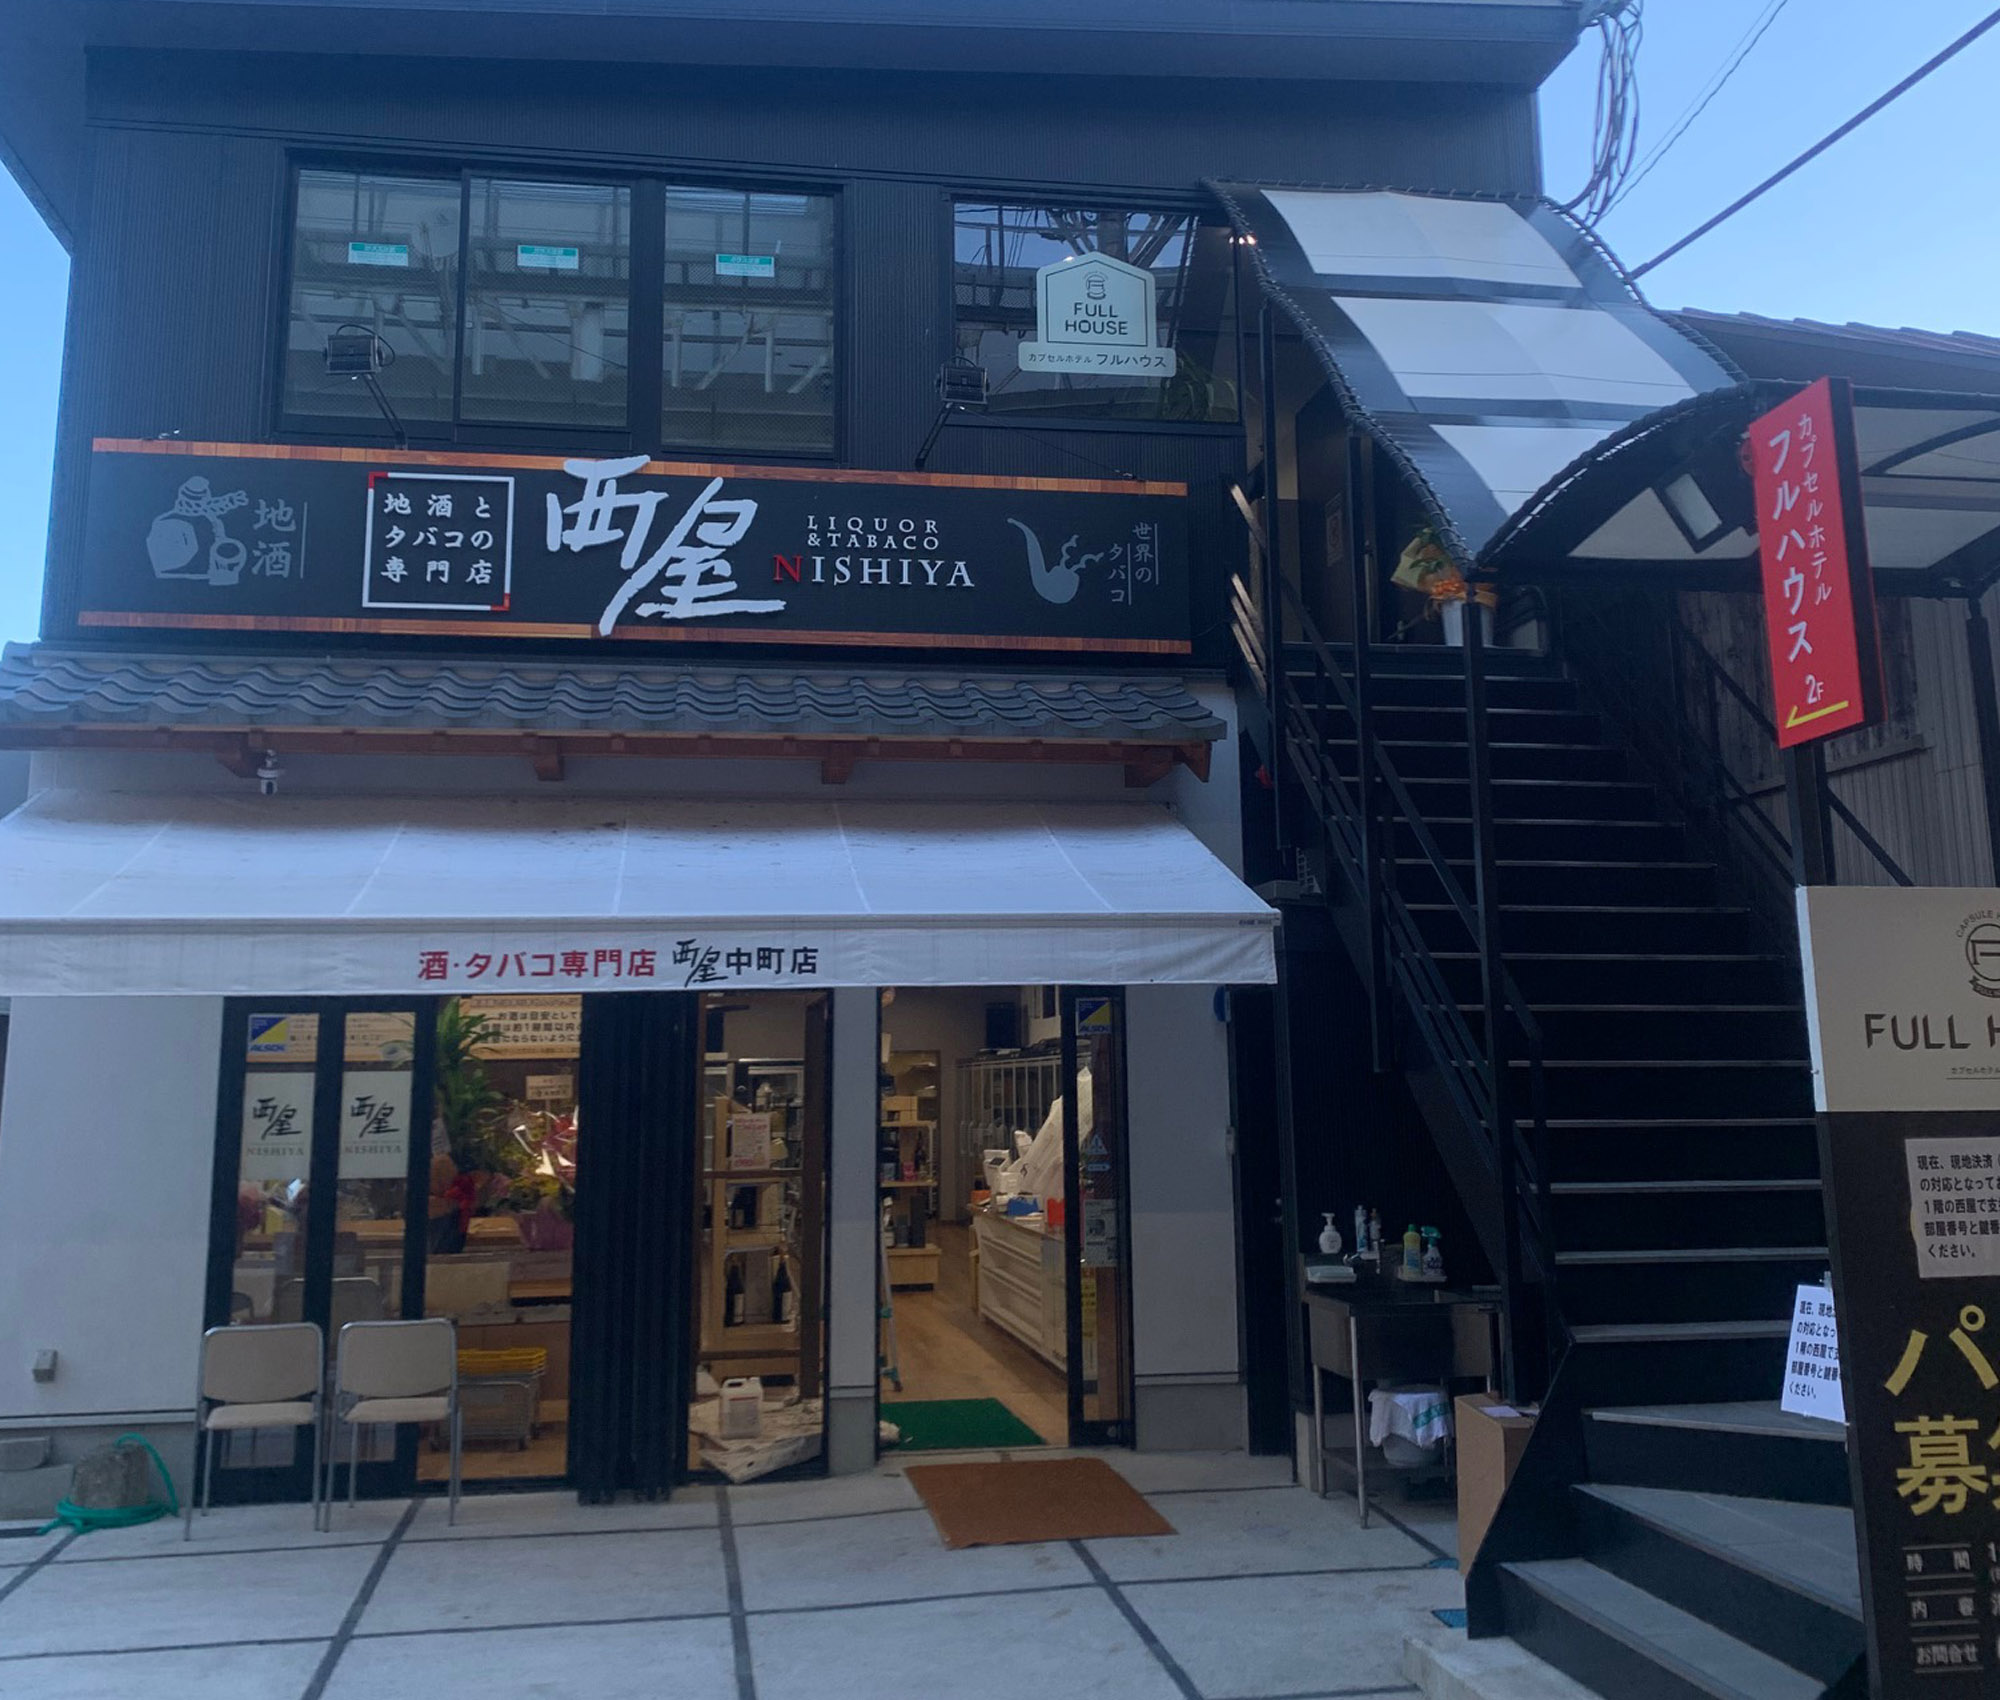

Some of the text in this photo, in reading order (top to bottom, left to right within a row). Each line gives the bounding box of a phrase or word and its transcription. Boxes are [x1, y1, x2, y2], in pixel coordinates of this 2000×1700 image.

[1074, 302, 1118, 318] FULL
[1065, 319, 1128, 336] HOUSE
[1096, 353, 1167, 368] フルハウス
[807, 515, 939, 534] LIQUOR
[1798, 413, 1832, 606] カプセルホテル
[252, 498, 297, 578] 地酒
[385, 525, 494, 550] タバコの
[1132, 522, 1154, 583] 世界の
[1769, 429, 1813, 663] フルハウス
[380, 556, 492, 584] 専門店
[773, 554, 975, 587] NISHIYA
[1107, 543, 1126, 602] タバコ
[1805, 674, 1824, 704] 2F
[1865, 1013, 1972, 1050] FULL
